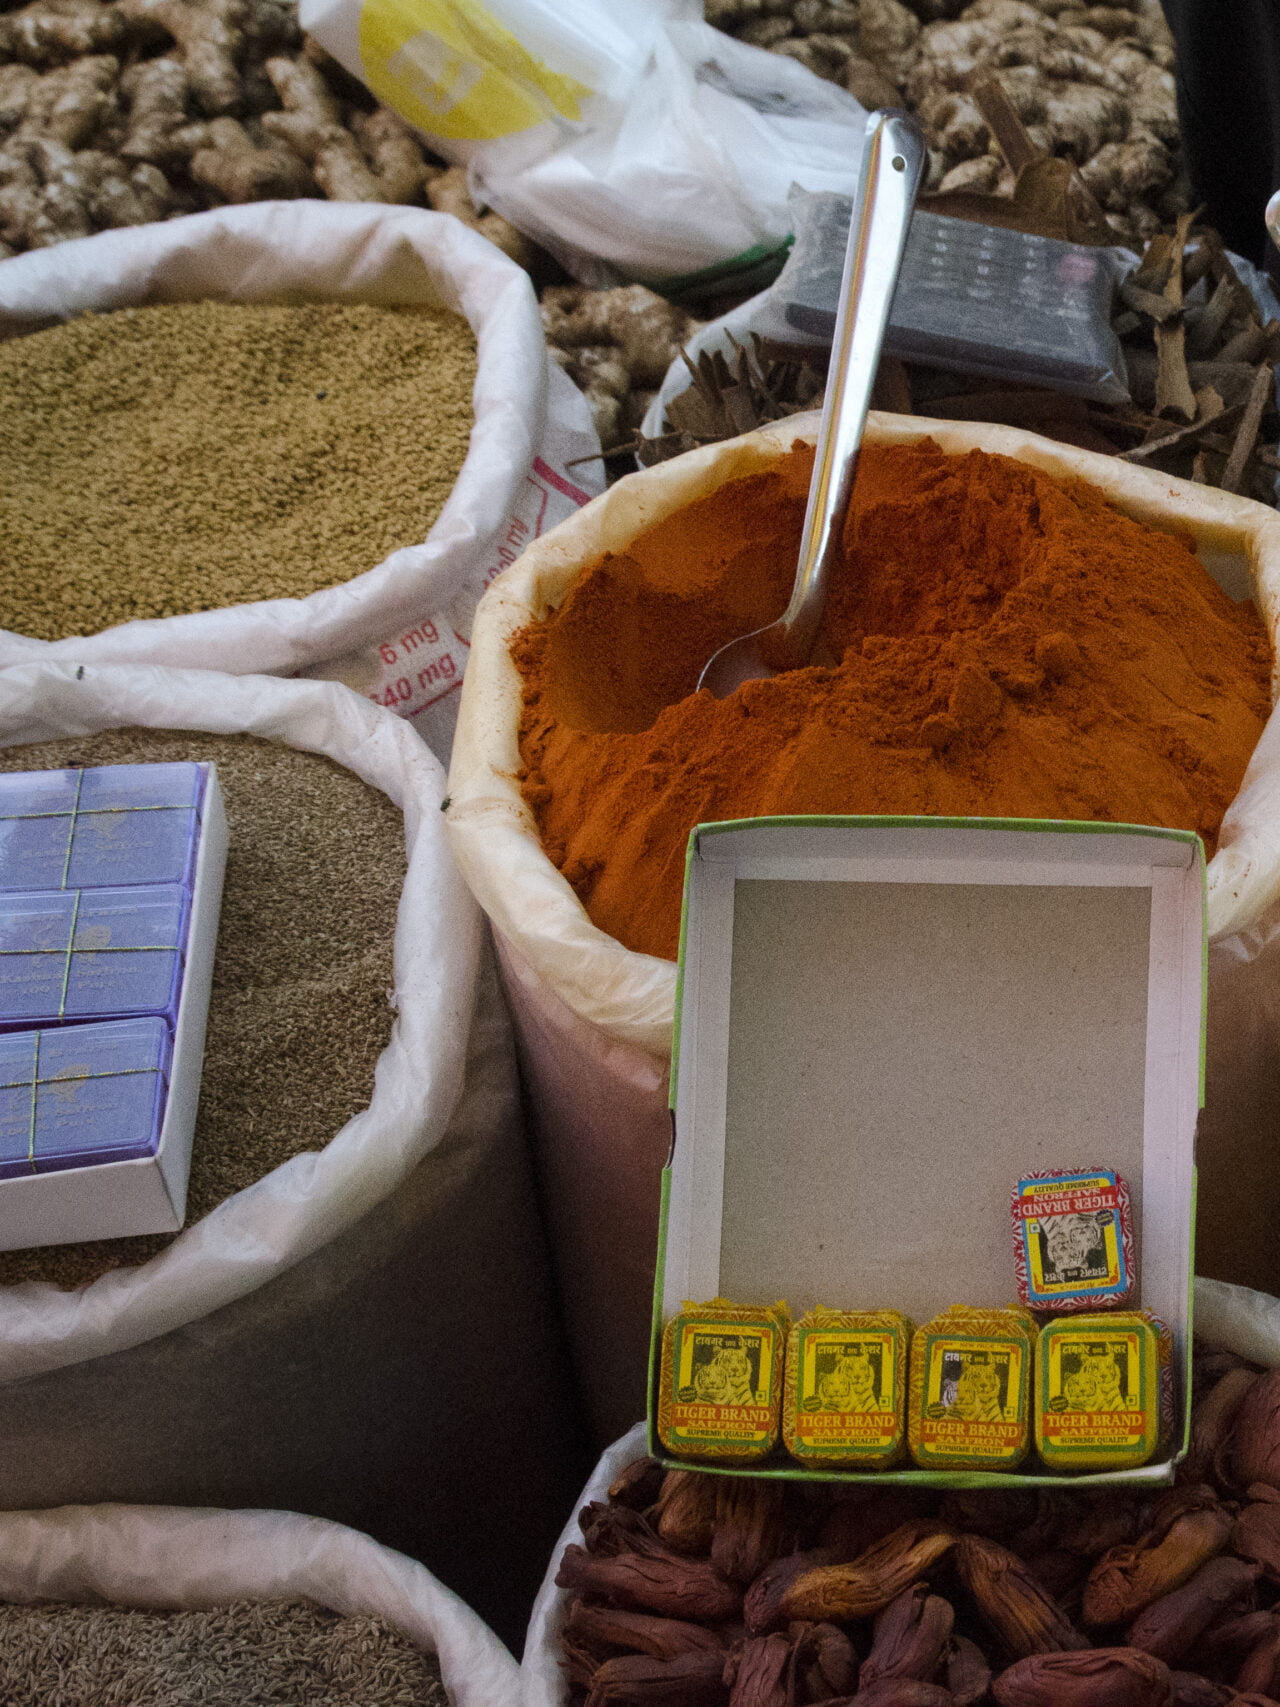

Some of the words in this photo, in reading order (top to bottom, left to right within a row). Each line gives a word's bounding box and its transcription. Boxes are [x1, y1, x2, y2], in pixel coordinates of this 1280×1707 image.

[400, 619, 440, 653] mg
[417, 653, 456, 689] mg
[1033, 1188, 1101, 1202] SAFFRON
[1075, 1194, 1116, 1210] TIGER
[1022, 1199, 1071, 1216] BRAND
[675, 1406, 717, 1420] TIGER
[720, 1407, 770, 1422] BRAND
[1046, 1414, 1089, 1428] TIGER
[1092, 1414, 1142, 1427] BRAND
[687, 1420, 756, 1431] SAFFRON
[801, 1415, 842, 1428] TIGER
[845, 1415, 895, 1428] BRAND
[812, 1428, 881, 1436] SAFFRON
[923, 1421, 966, 1435] TIGER
[968, 1424, 1019, 1438] BRAND
[1060, 1427, 1131, 1435] SAFFRON
[935, 1436, 1006, 1447] SAFFRON
